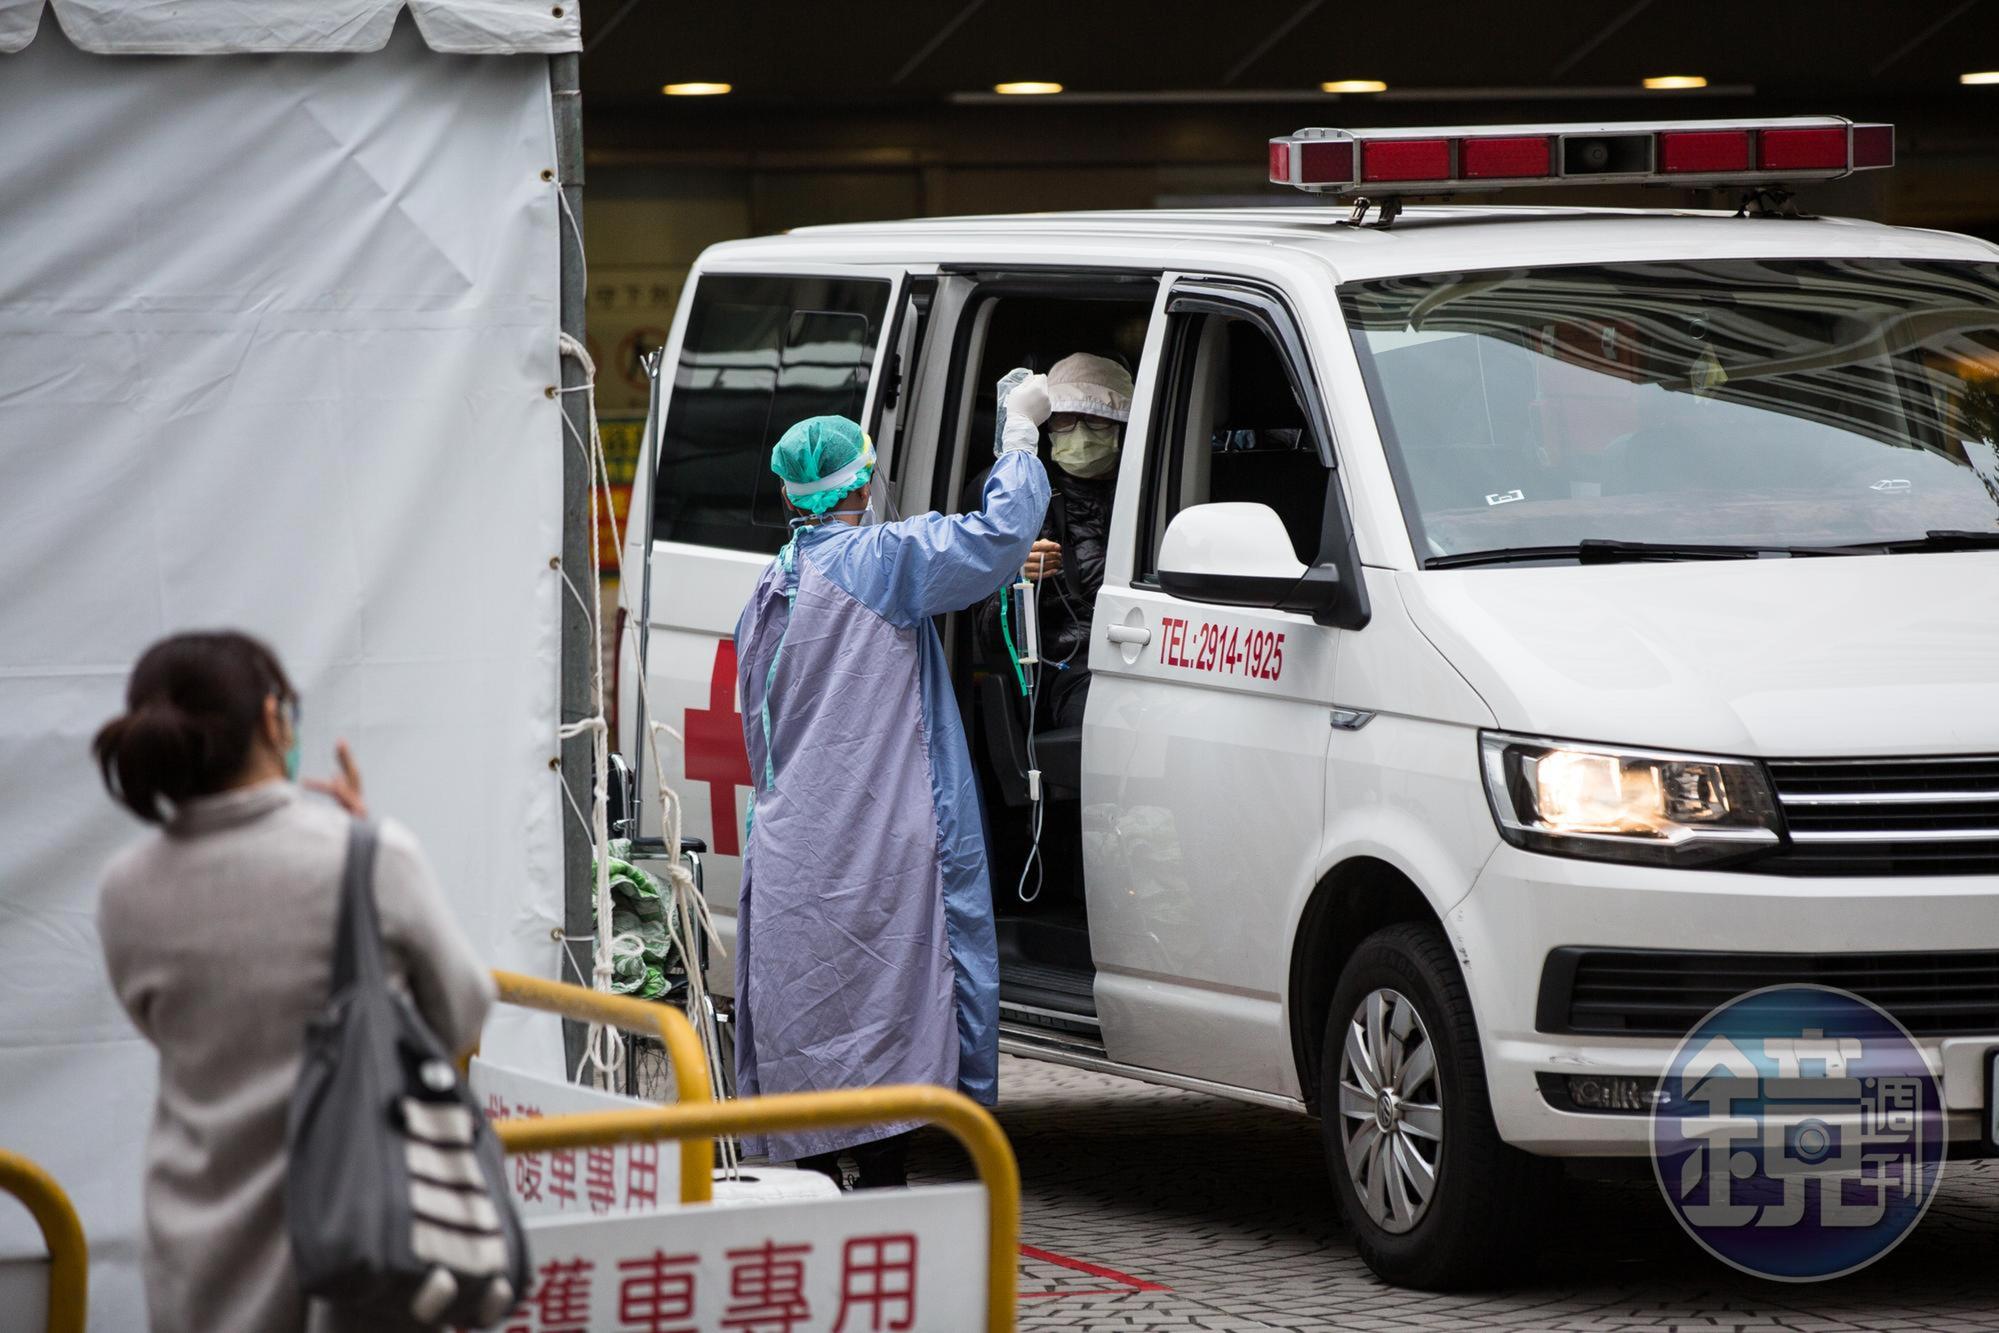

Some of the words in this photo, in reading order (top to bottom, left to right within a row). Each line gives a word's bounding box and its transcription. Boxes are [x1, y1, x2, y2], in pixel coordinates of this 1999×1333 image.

[1160, 617, 1285, 681] TEL:2914-1925
[484, 1093, 658, 1214] 護車專用
